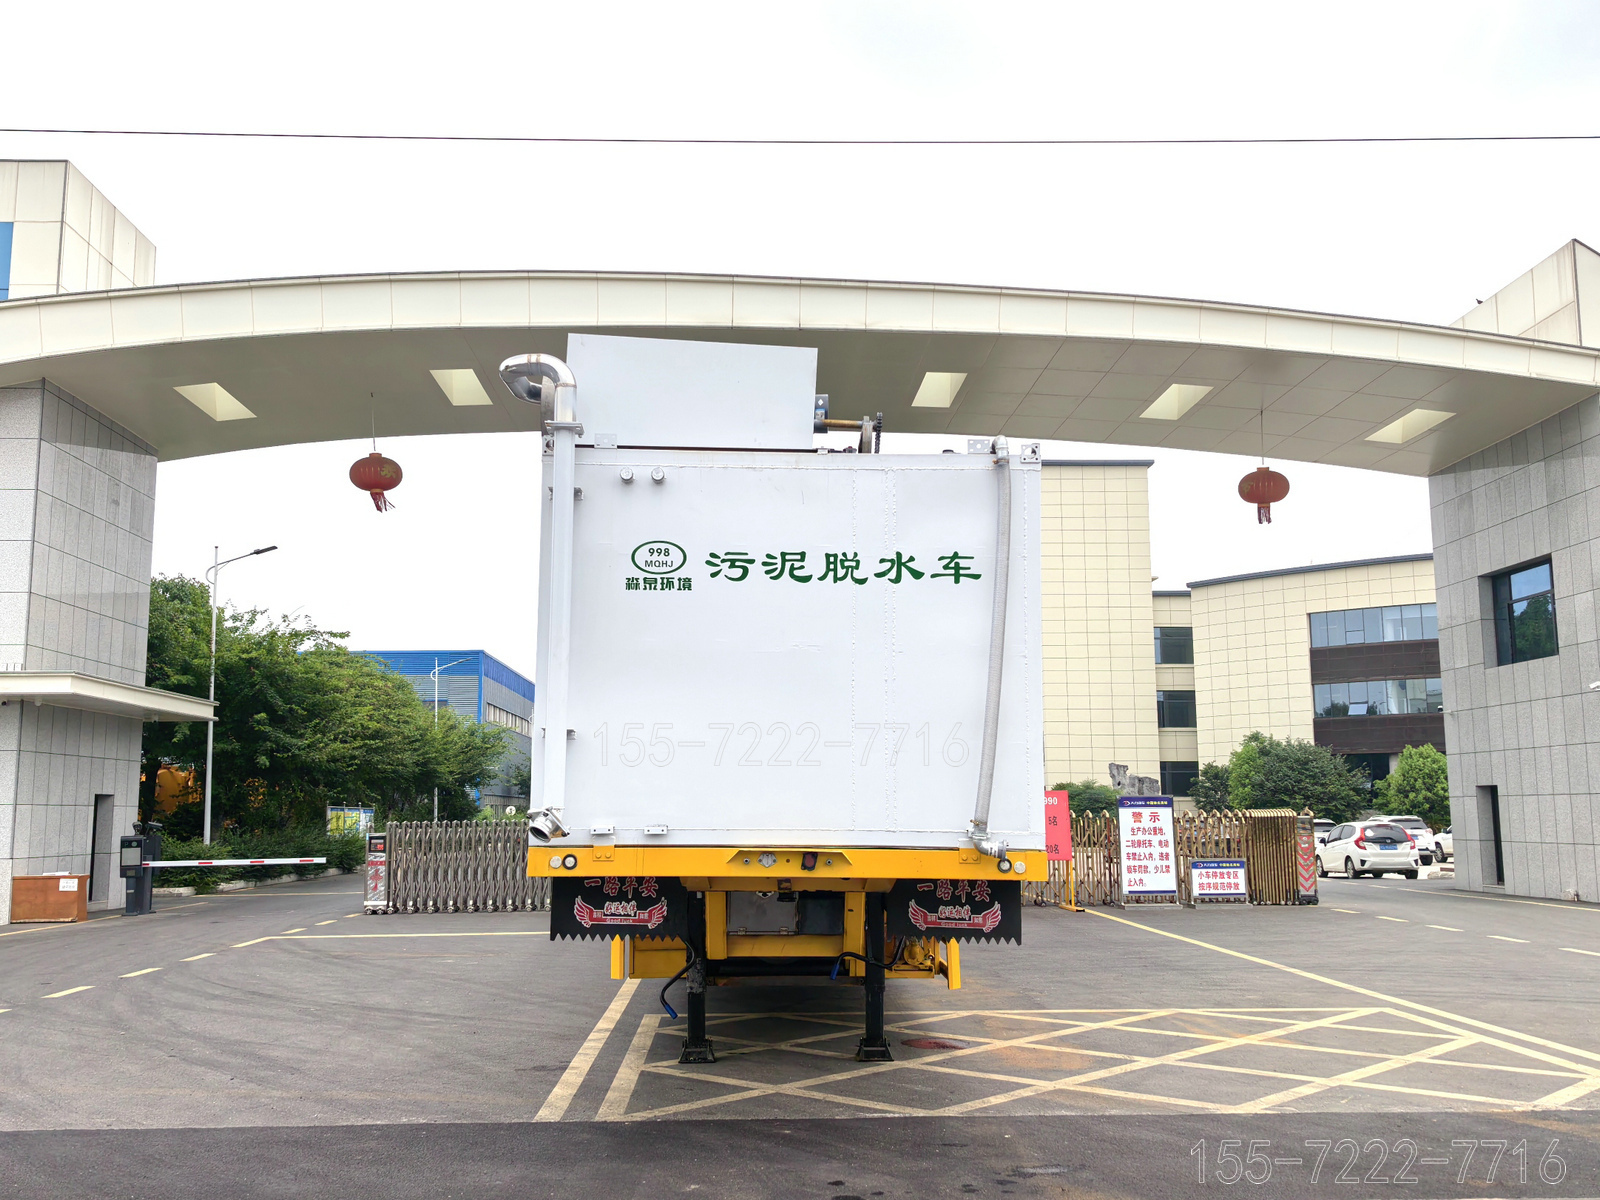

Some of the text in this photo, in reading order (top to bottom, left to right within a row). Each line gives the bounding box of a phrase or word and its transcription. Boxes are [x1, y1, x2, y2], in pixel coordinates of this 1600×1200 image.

[648, 547, 670, 557] 998
[644, 560, 674, 568] MQHJ
[705, 551, 982, 585] 污泥脱水车
[625, 577, 693, 591] 淼泉环境
[1131, 812, 1160, 823] 警示
[1198, 871, 1239, 879] 小车停放专区
[584, 876, 659, 898] 一路平安
[917, 880, 991, 903] 一路平安
[1198, 882, 1240, 891] 按序规范停放
[938, 905, 971, 921] 好运相伴
